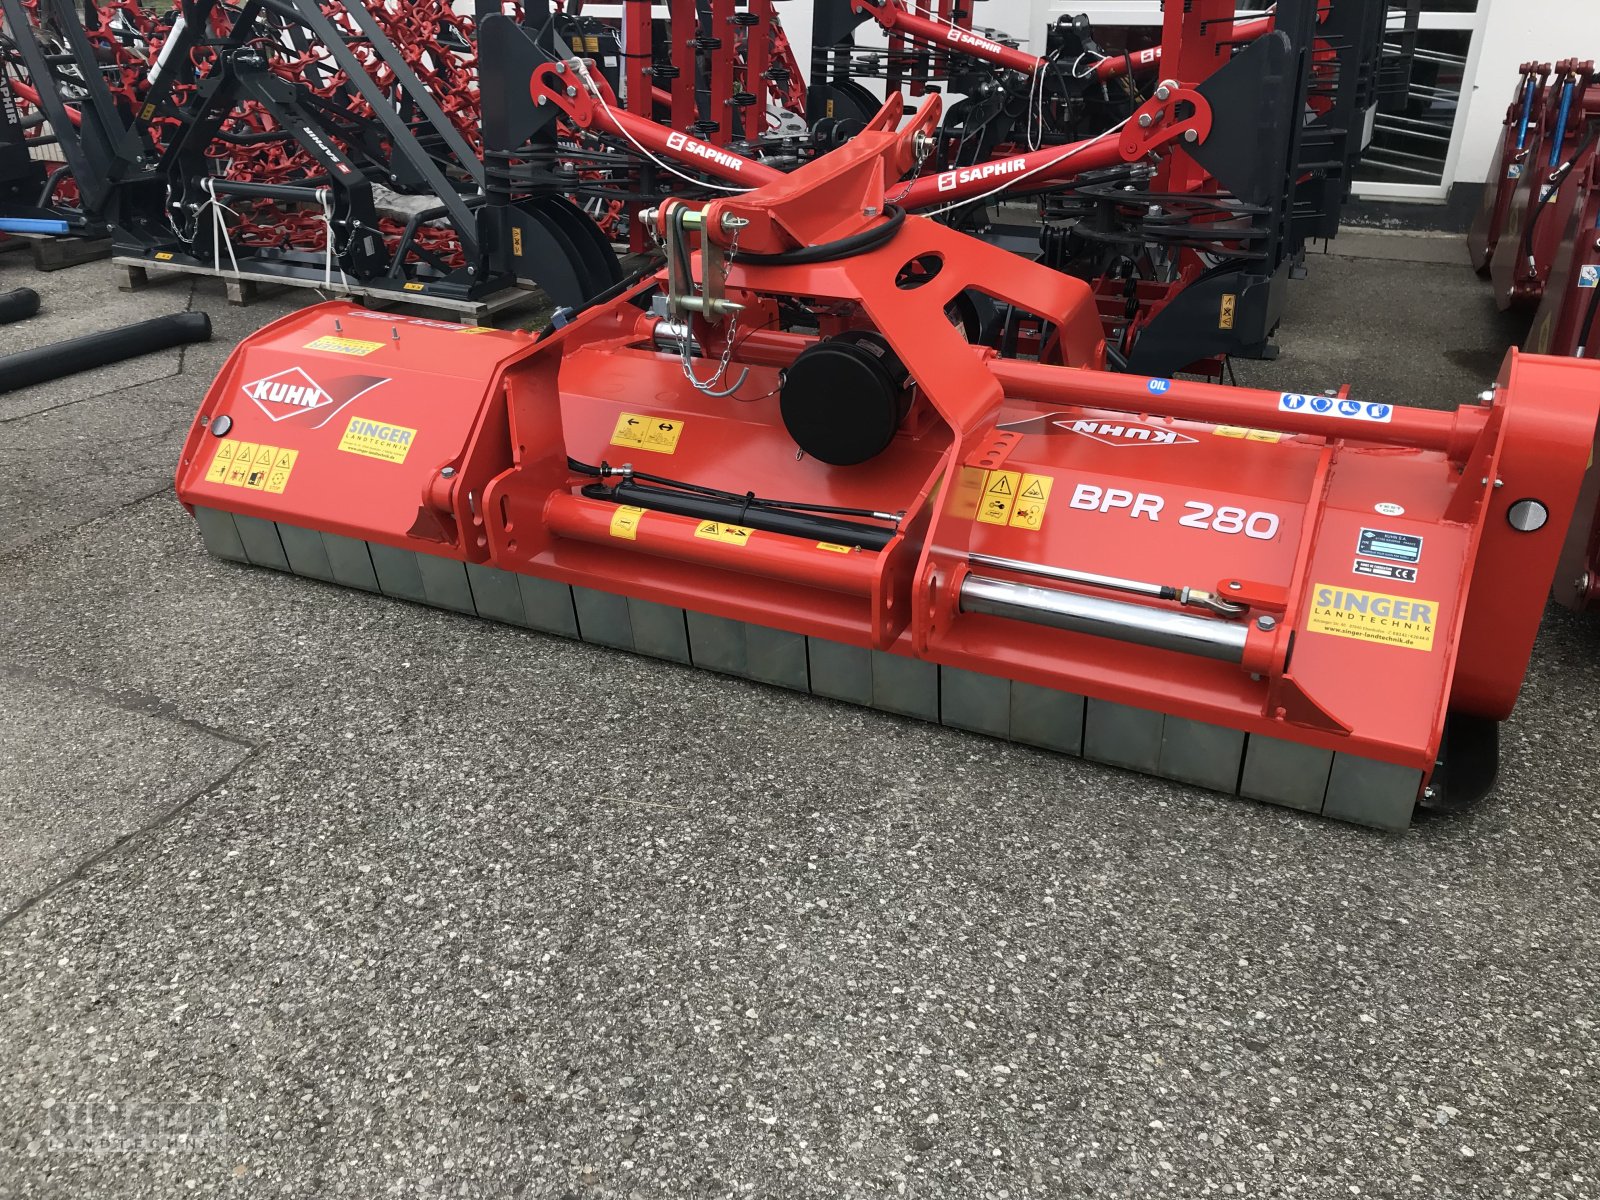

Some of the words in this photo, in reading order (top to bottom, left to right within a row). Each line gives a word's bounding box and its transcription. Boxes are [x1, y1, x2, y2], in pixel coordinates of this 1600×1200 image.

[960, 34, 1002, 54] SAPHIR
[302, 126, 340, 163] SAPHIR
[685, 140, 743, 171] SAPHIR
[959, 158, 1026, 184] SAPHIR
[252, 379, 321, 408] KUHN
[1149, 379, 1167, 391] OIL
[345, 433, 408, 451] LANDTECHNIK
[348, 419, 412, 446] SINGER
[1071, 420, 1178, 444] KUHN
[1069, 482, 1165, 522] BPR
[1178, 500, 1280, 541] 280
[1395, 568, 1409, 579] CE
[1316, 588, 1432, 624] SINGER
[1314, 607, 1432, 633] LANDTECHNIK
[1324, 625, 1414, 646] www.singer-landtechnik.de
